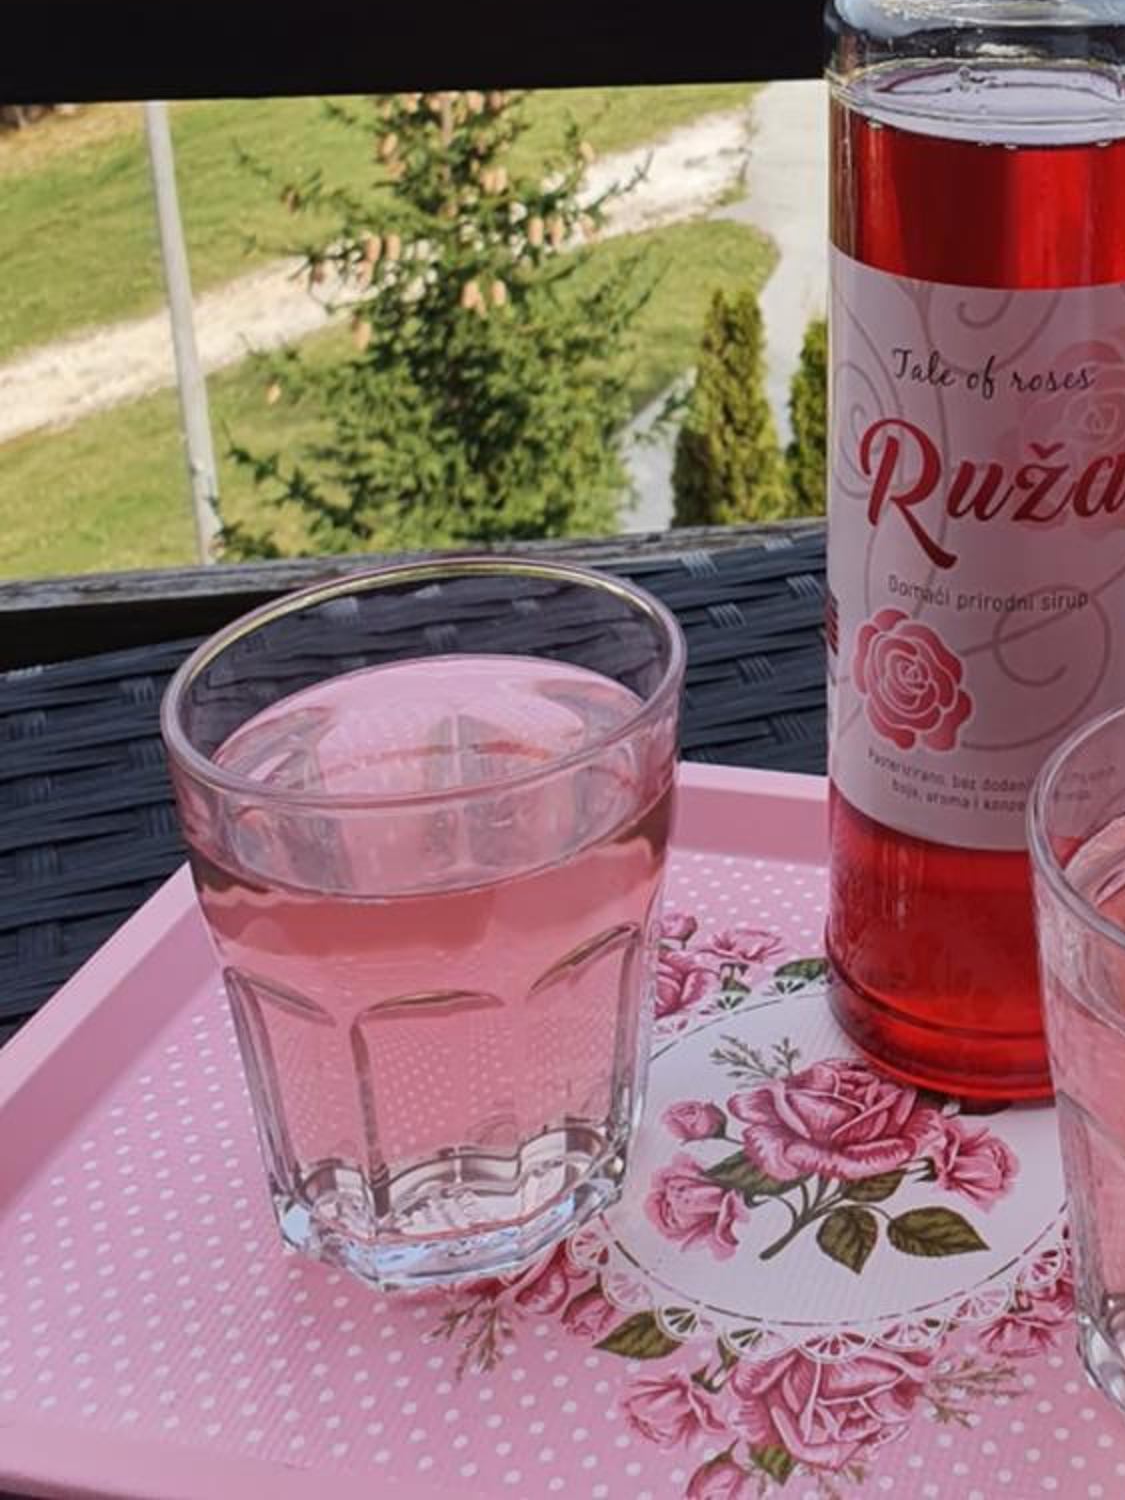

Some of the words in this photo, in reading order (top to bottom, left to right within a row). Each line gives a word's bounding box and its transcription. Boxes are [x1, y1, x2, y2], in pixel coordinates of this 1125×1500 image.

[892, 347, 955, 386] Tale
[966, 355, 996, 400] of
[1009, 367, 1096, 392] roses
[956, 591, 1034, 613] prirodni
[1039, 590, 1089, 613] sirup
